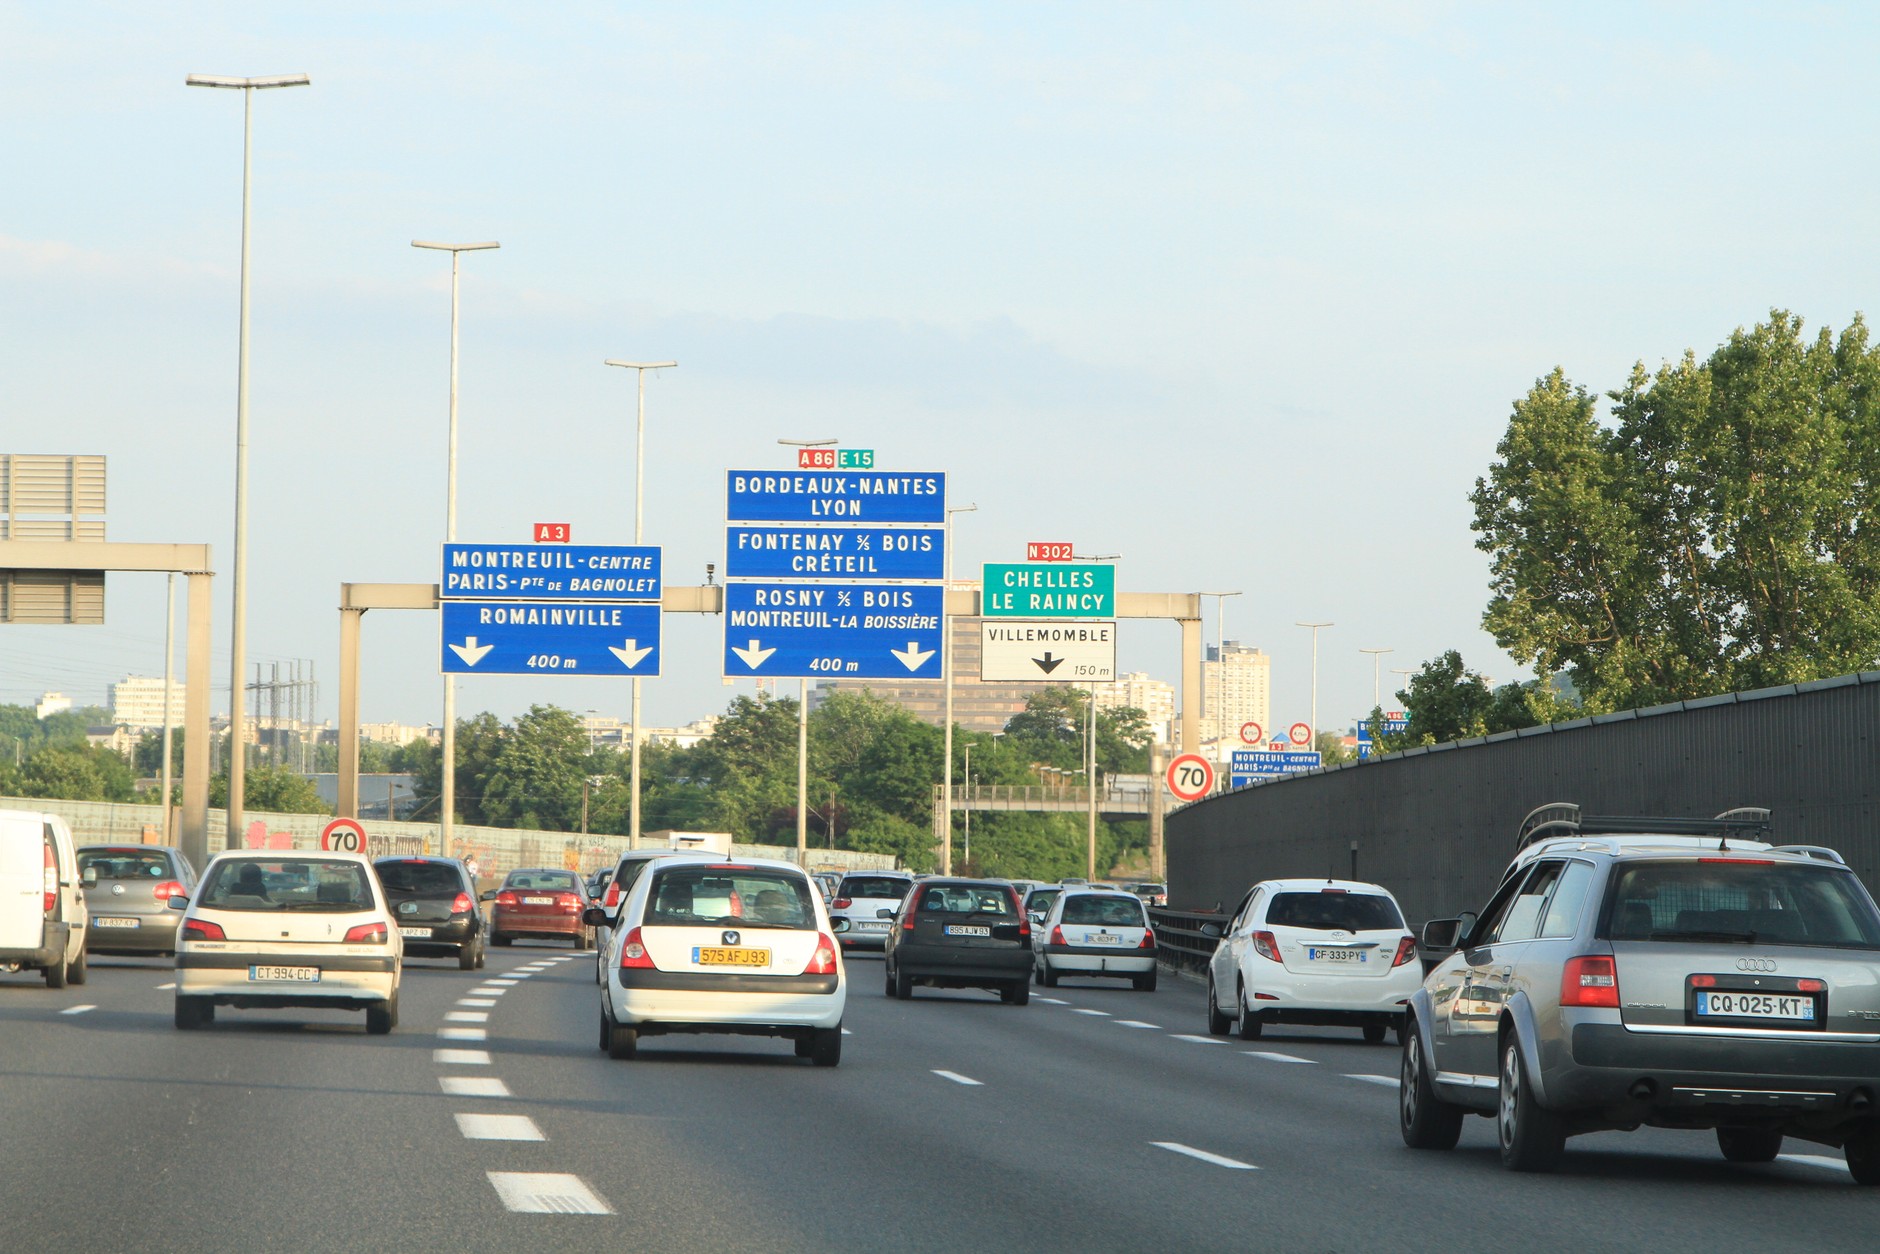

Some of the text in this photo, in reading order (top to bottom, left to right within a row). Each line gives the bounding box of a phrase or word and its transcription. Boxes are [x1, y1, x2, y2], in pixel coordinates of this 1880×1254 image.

[801, 452, 833, 465] A 86
[840, 452, 871, 465] E 15
[735, 477, 937, 495] BORDEAUX-NANTES
[811, 500, 861, 516] LYON
[540, 526, 564, 539] A 3
[738, 533, 844, 550] FONTENAY
[883, 535, 932, 551] BOIS
[1029, 545, 1071, 559] N 302
[452, 551, 652, 570] MONTREUIL-CENTRE
[792, 553, 878, 573] CRÉTEIL
[547, 582, 562, 591] DE
[569, 578, 656, 592] BAGNOLET
[1003, 571, 1094, 588] CHELLES
[755, 589, 824, 606] ROSNY
[863, 591, 913, 608] BOIS
[992, 593, 1104, 610] LE RAINCY
[480, 608, 622, 626] ROMAINVILLE
[731, 610, 938, 630] MONTREUIL-LA BOISSIÈRE
[988, 629, 1109, 642] VILLEMOMBLE
[527, 654, 577, 669] 400 m
[809, 657, 859, 672] 400 m
[1074, 665, 1096, 675] 150
[1235, 753, 1317, 763] MONTREUIL-CENTRE
[1179, 767, 1205, 787] 70
[331, 832, 358, 851] 70
[949, 925, 964, 934] 895
[978, 927, 989, 935] 93
[702, 949, 766, 963] 575 AFJ 93
[1315, 950, 1361, 960] CF-333-PY
[257, 967, 311, 980] CT-994-CC
[1710, 994, 1801, 1016] CQ-025-KT
